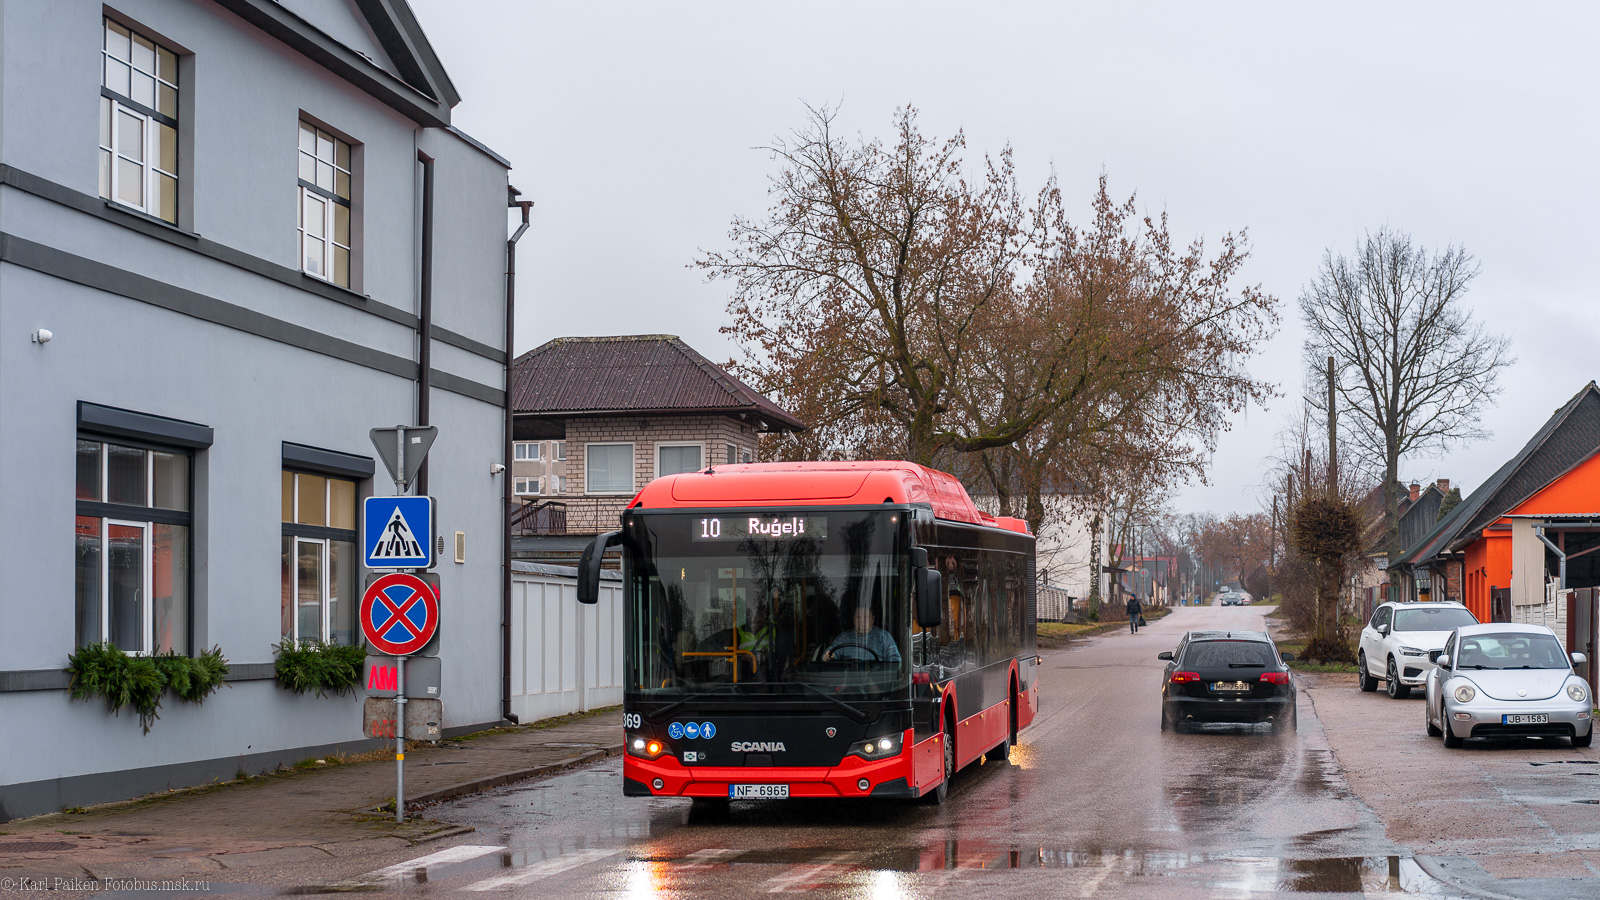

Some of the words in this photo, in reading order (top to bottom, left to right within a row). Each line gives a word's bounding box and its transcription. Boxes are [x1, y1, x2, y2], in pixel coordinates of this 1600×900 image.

[702, 518, 720, 537] 10
[748, 517, 805, 537] Ruģeļi
[731, 741, 786, 752] SCANIA
